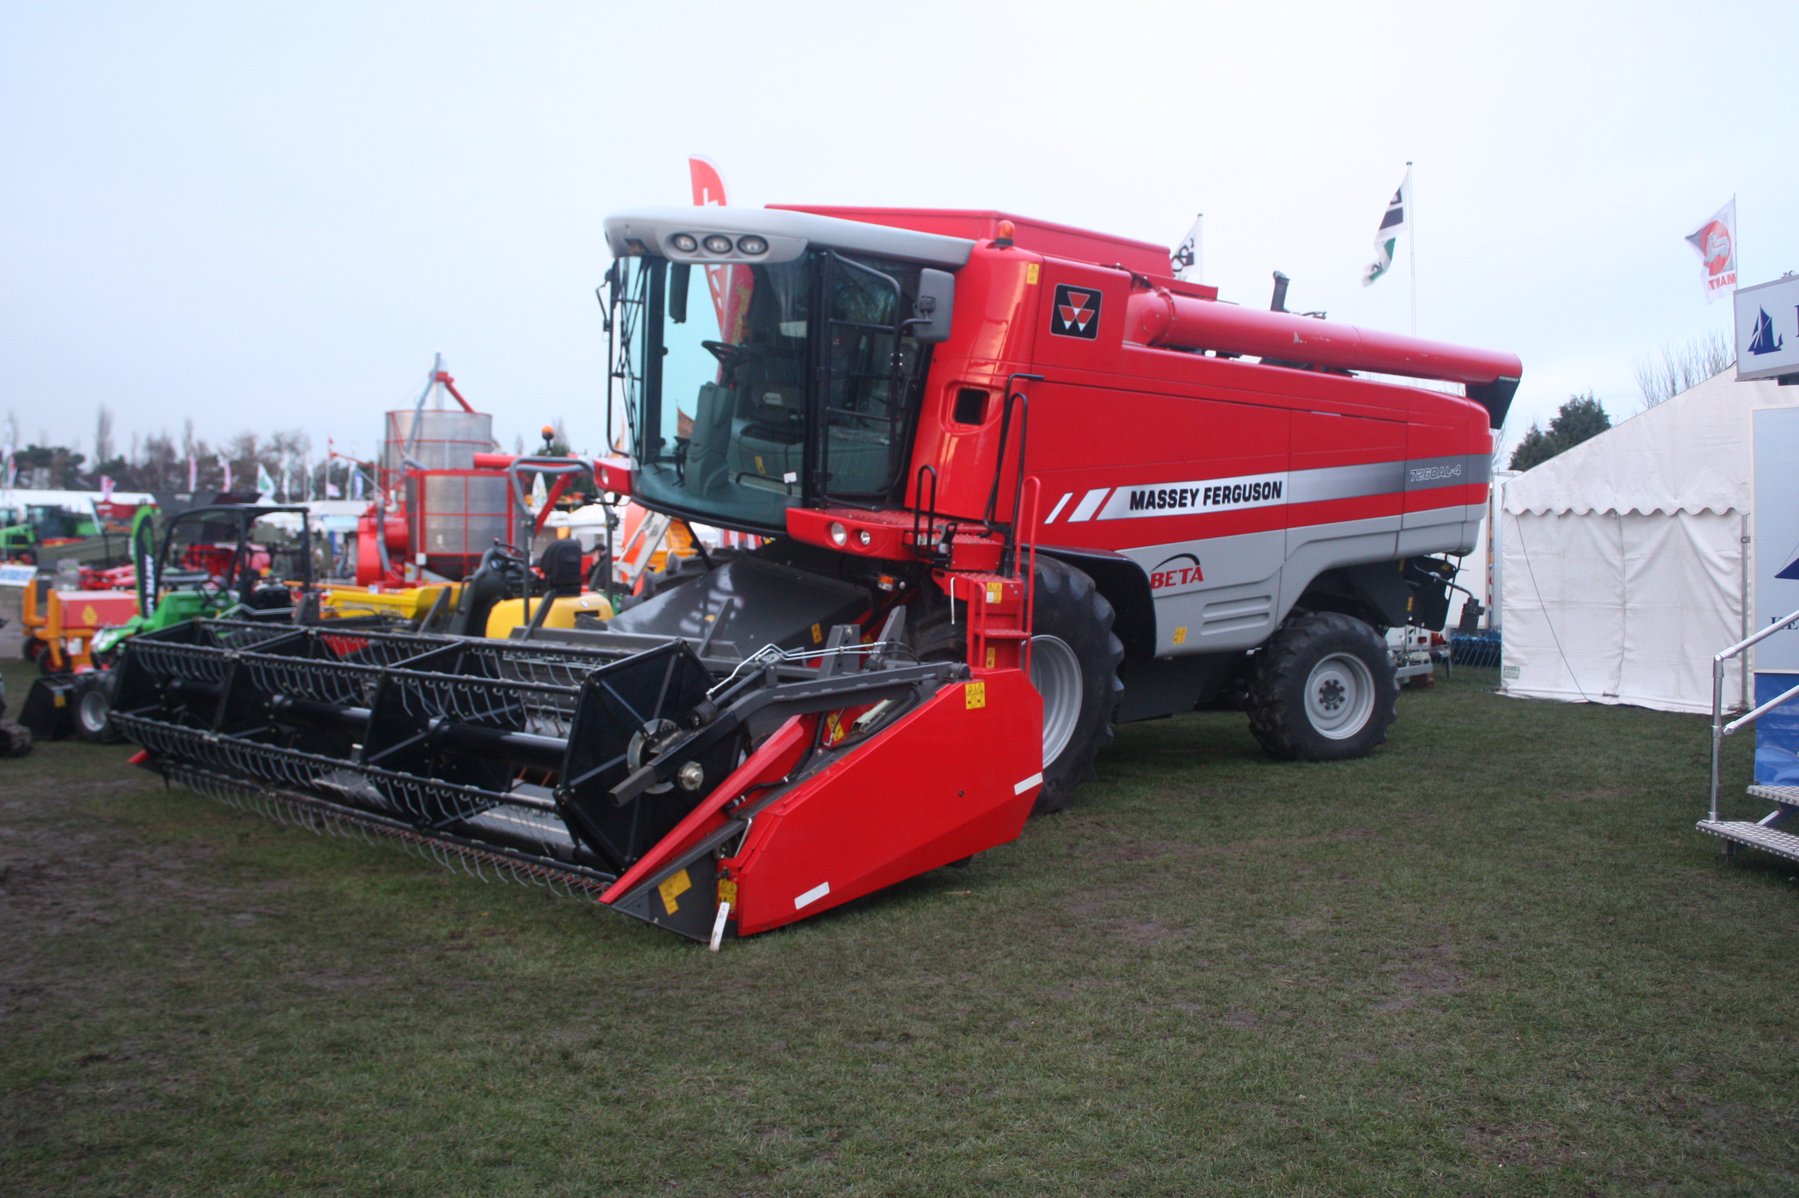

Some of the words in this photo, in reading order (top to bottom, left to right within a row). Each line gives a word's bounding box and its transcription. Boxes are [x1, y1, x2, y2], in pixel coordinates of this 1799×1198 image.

[1129, 487, 1200, 511] MASSEY
[1203, 481, 1283, 506] FERGUSON
[1150, 566, 1204, 590] BETA
